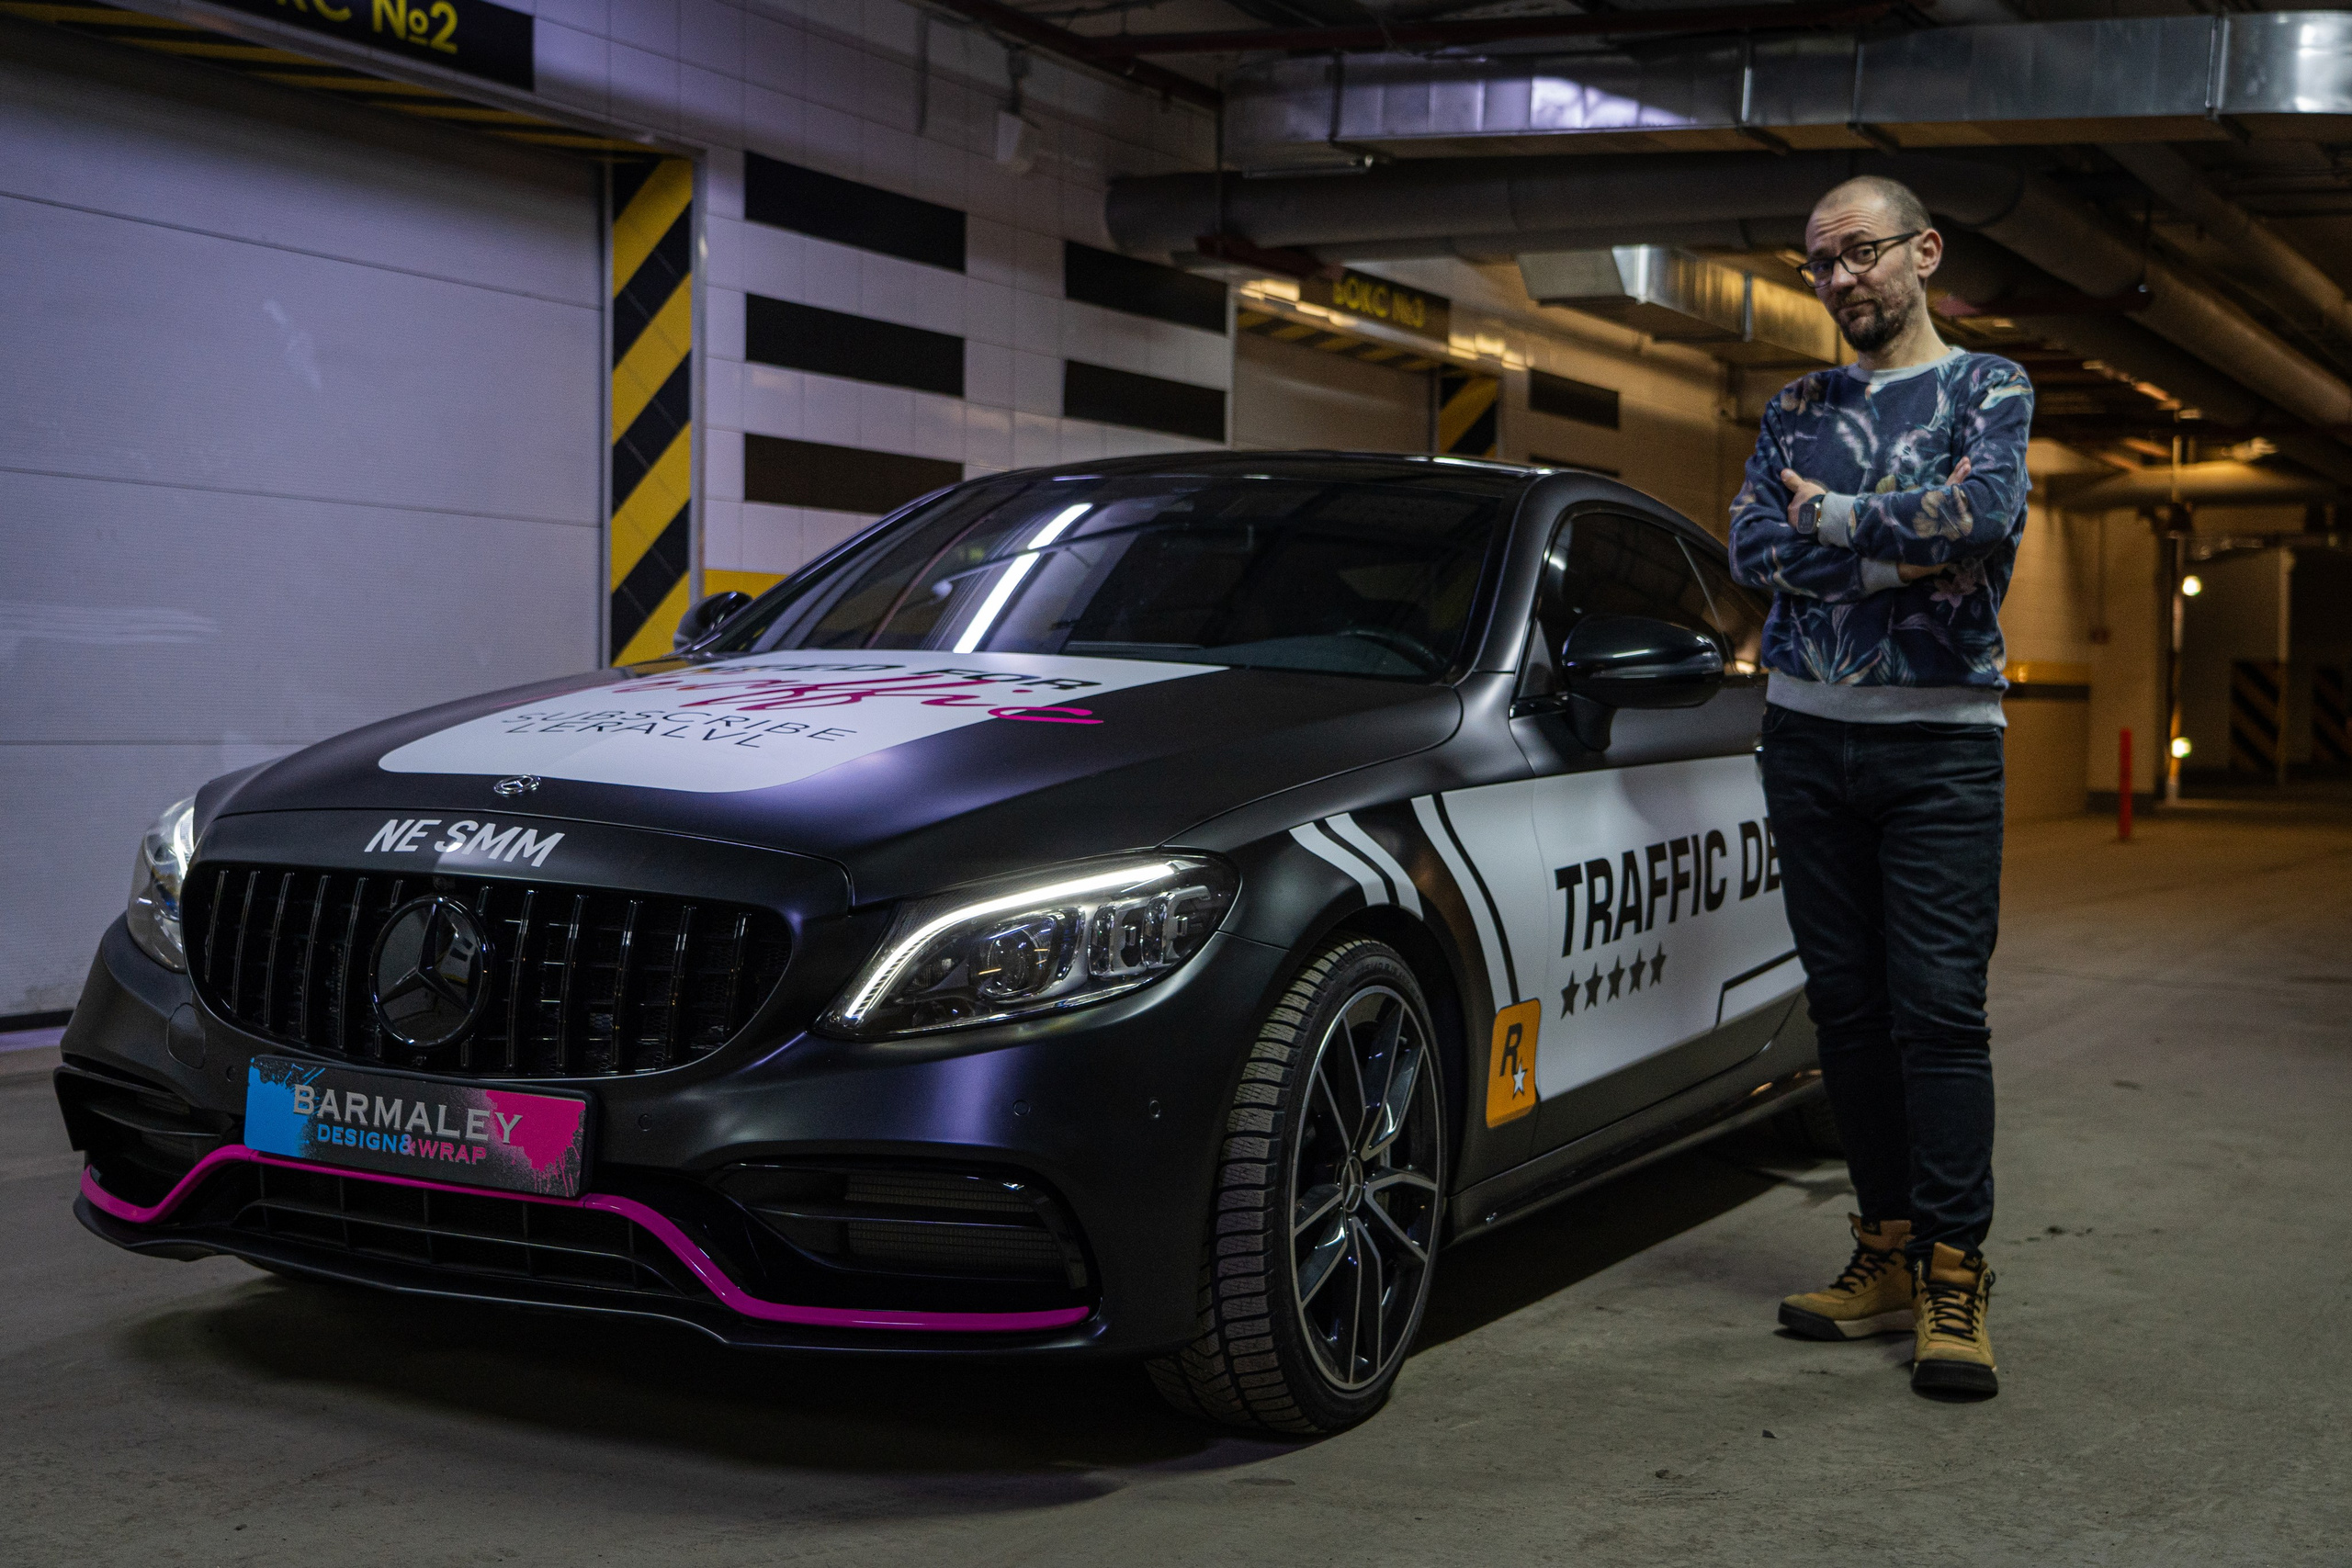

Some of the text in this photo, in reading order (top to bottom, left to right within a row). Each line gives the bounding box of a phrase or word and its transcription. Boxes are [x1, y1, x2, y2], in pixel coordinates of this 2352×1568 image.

[910, 669, 1102, 691] FOR
[502, 710, 857, 742] SUBSCRIBE
[505, 721, 763, 749] LERALVL
[364, 818, 565, 868] NE SMM
[1554, 829, 1727, 958] TRAFFIC
[293, 1083, 524, 1145] BARMALEY
